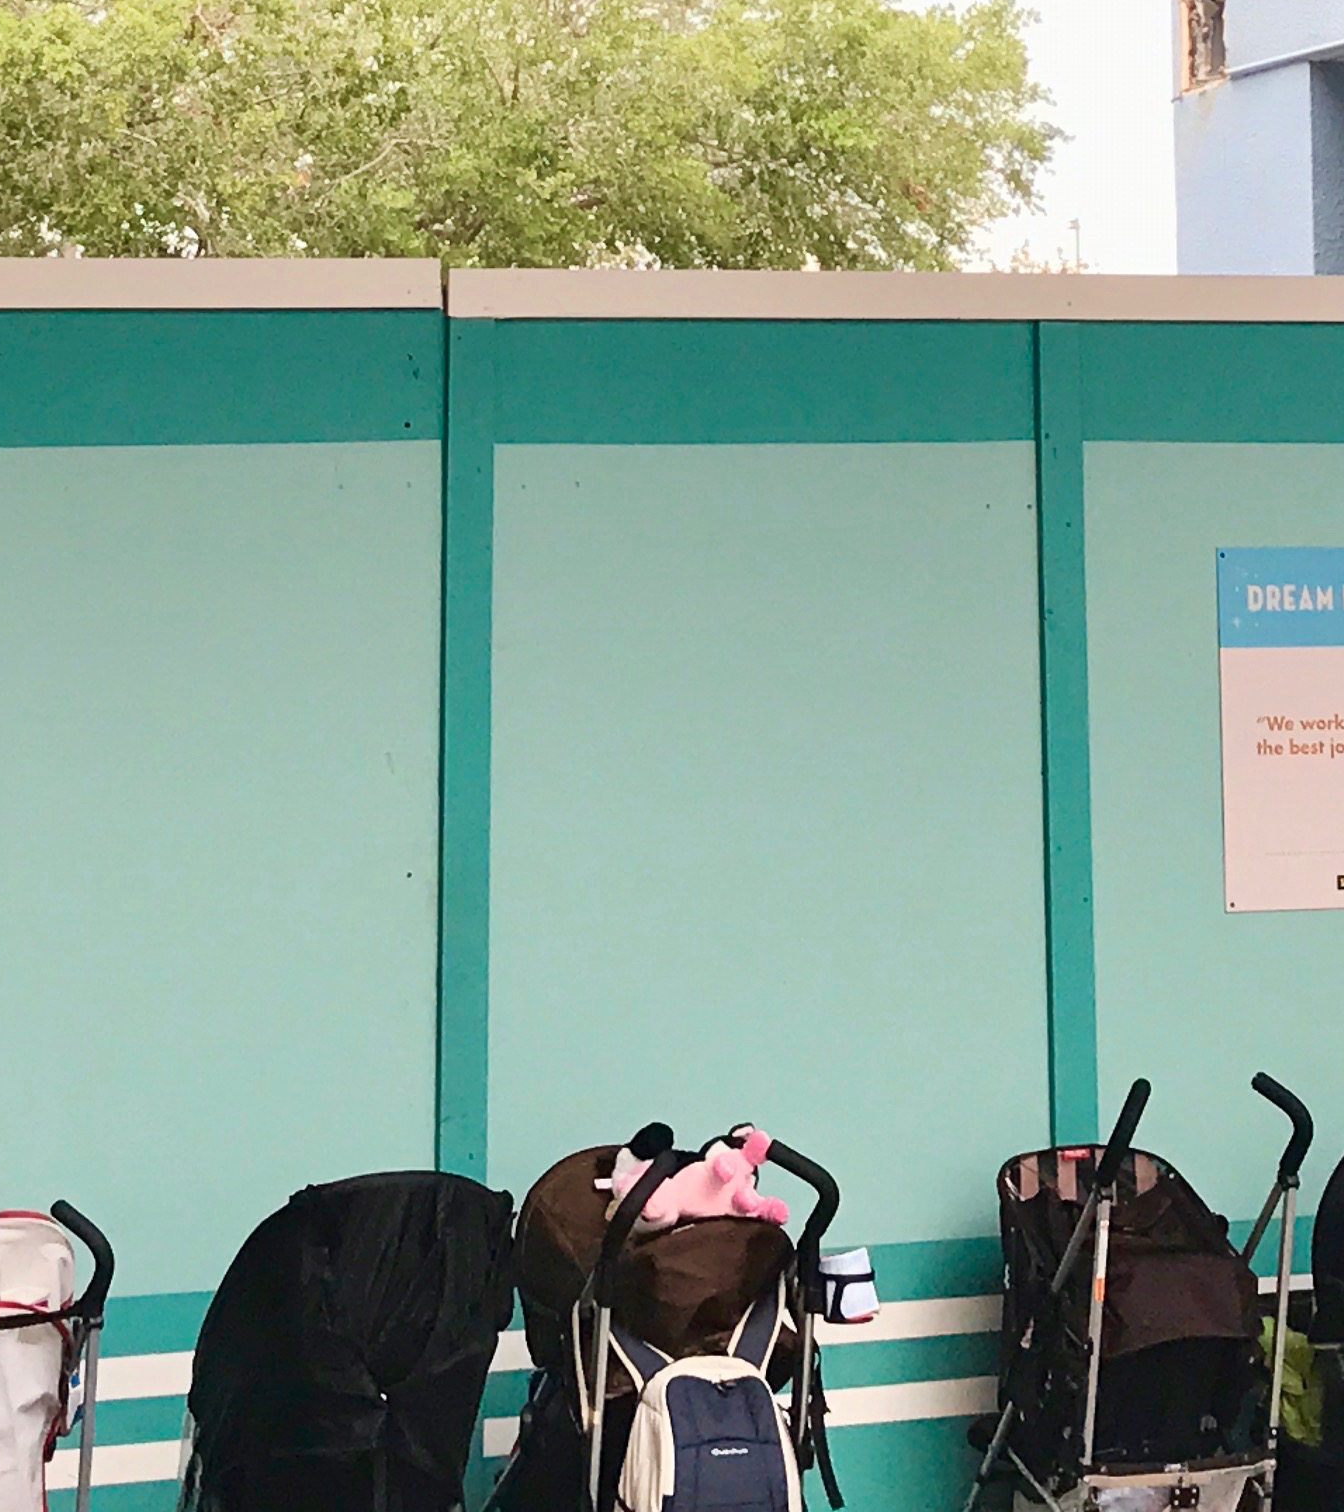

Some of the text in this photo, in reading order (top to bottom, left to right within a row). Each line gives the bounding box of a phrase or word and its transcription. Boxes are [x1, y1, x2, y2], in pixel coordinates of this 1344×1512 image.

[1247, 584, 1333, 612] DREAM
[1257, 716, 1294, 731] "We
[1300, 714, 1344, 730] work
[1257, 739, 1283, 755] the
[1289, 738, 1324, 755] best
